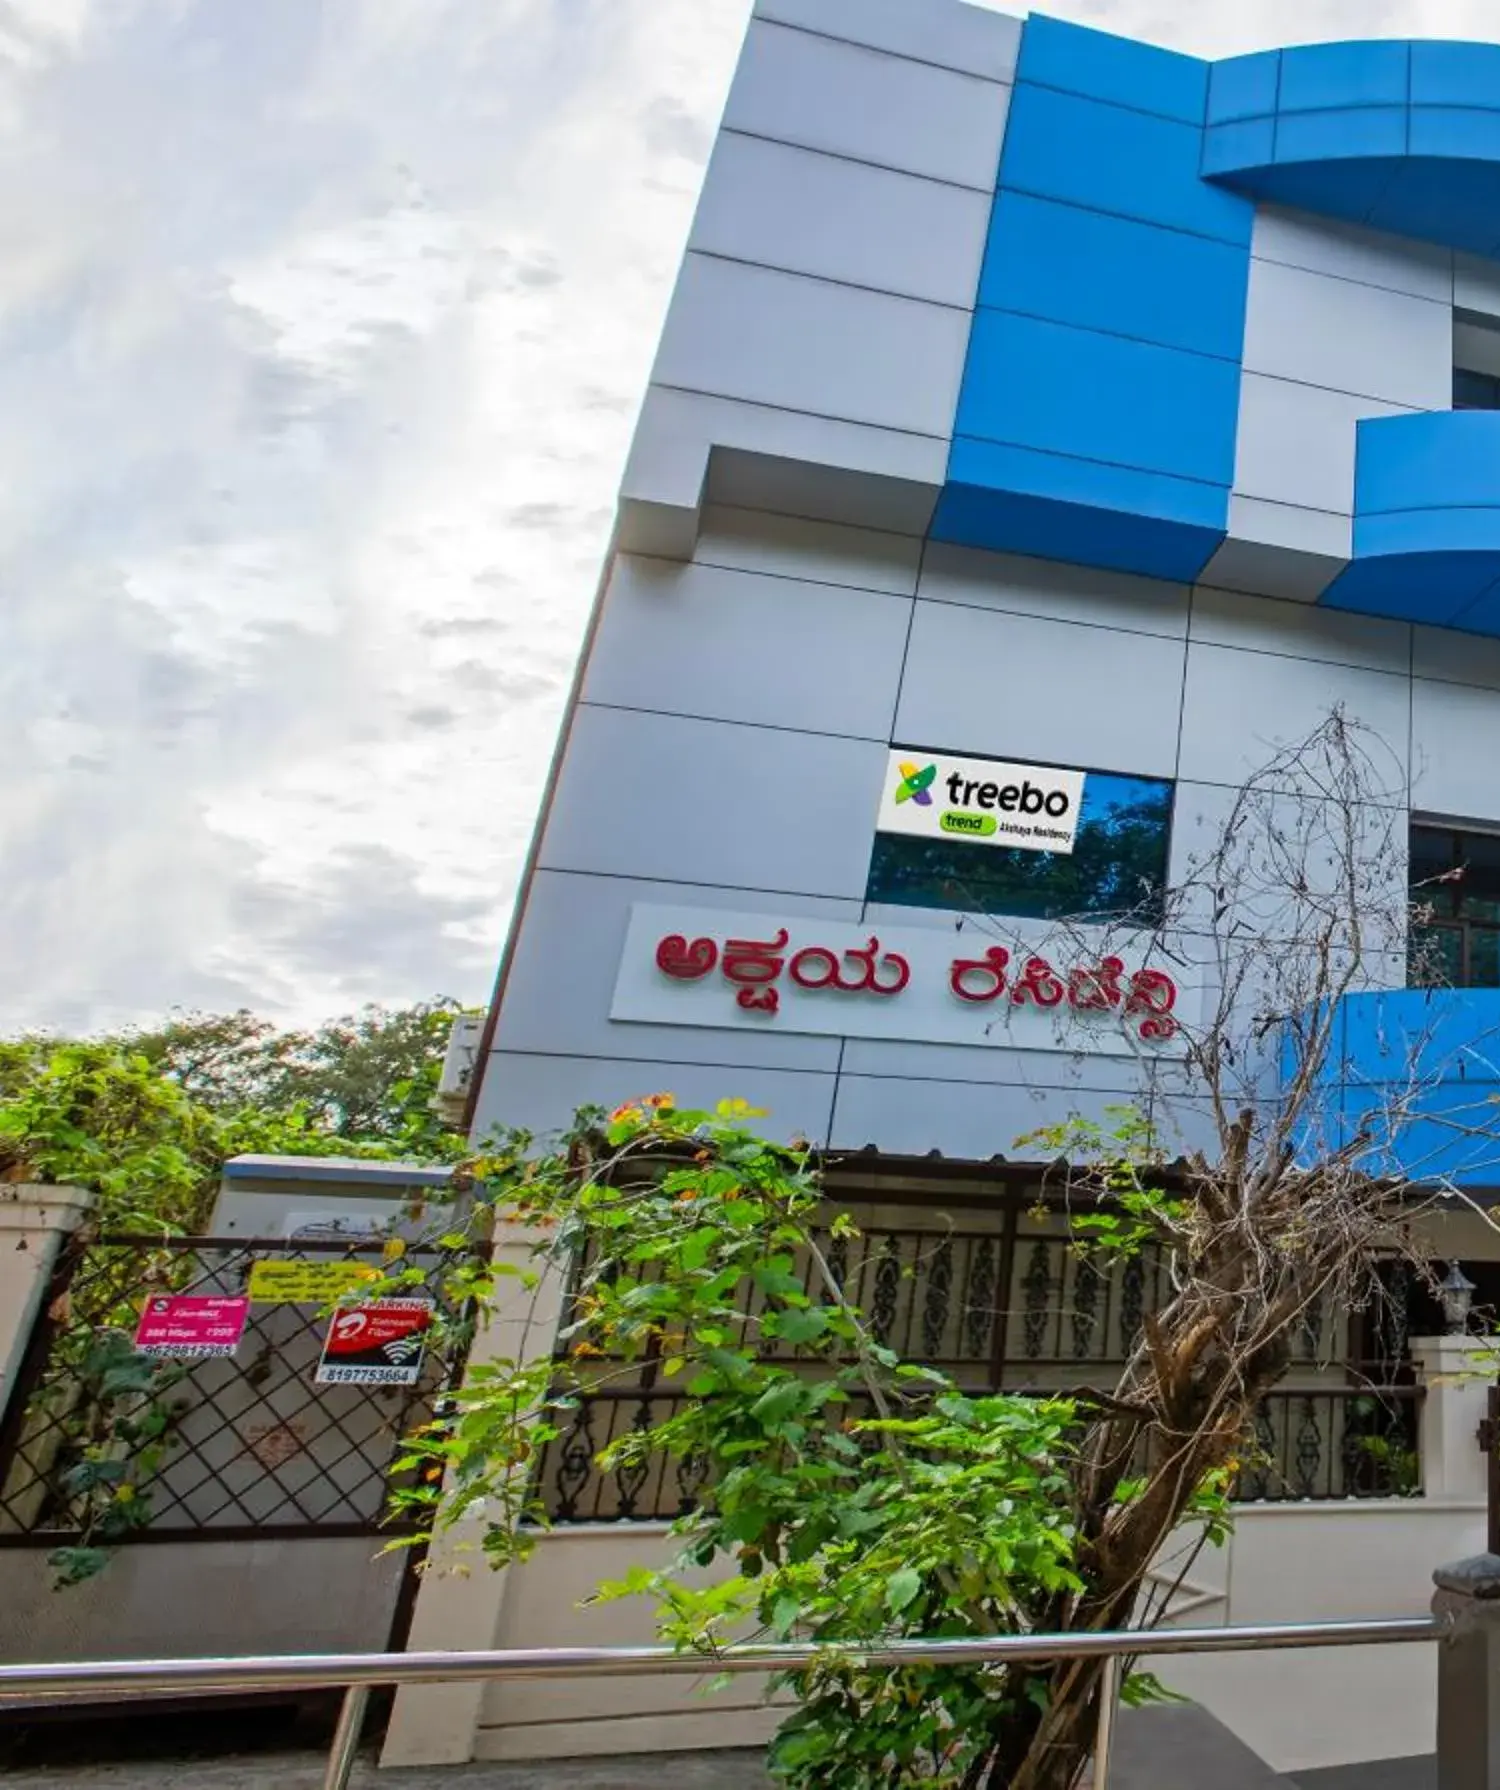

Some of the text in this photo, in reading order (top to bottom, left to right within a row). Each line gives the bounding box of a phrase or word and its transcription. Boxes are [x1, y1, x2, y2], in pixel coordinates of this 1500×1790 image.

[945, 772, 1068, 817] treebo
[945, 814, 983, 829] trend
[655, 927, 911, 1015] ಅಕ್ಷಯ
